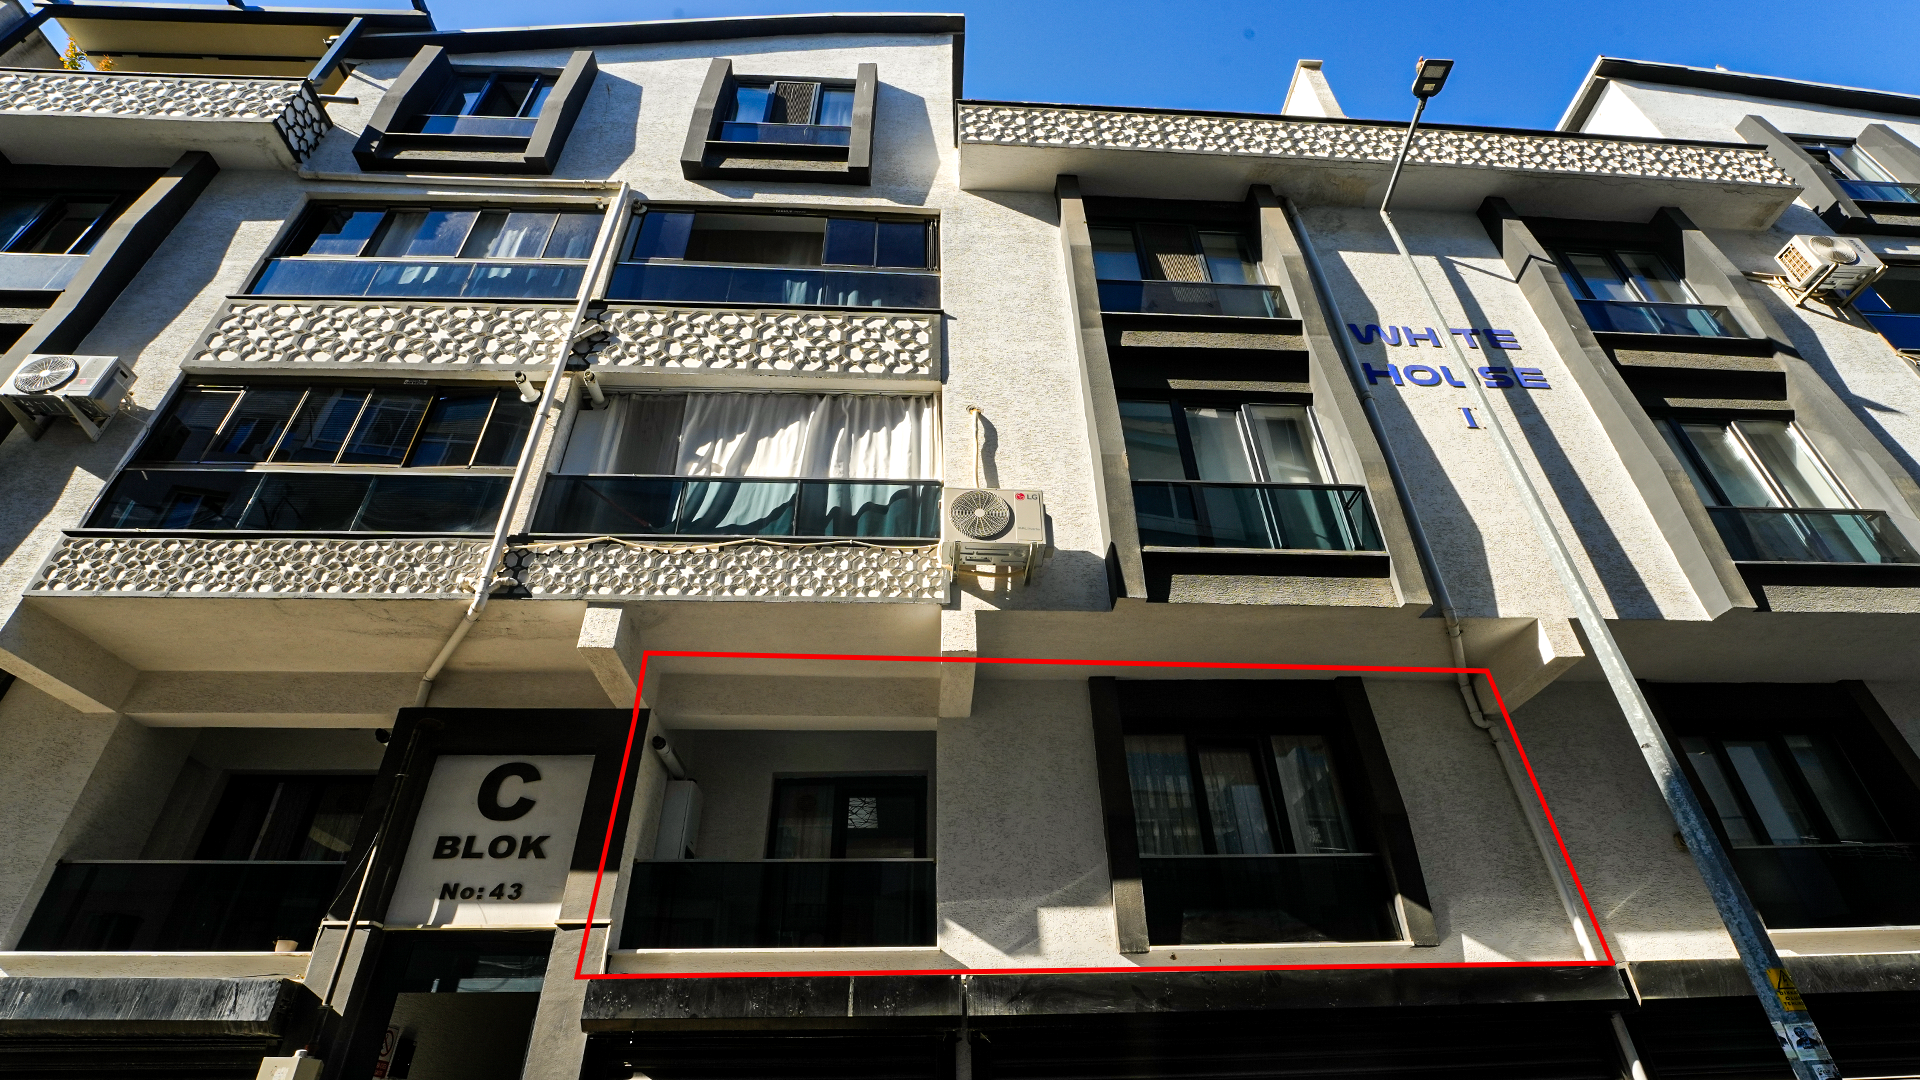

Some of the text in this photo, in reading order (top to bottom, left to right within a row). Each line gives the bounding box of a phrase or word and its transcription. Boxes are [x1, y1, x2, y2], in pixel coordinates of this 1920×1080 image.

[1348, 323, 1522, 350] WHTE
[477, 762, 542, 821] C
[433, 835, 551, 860] BLOK
